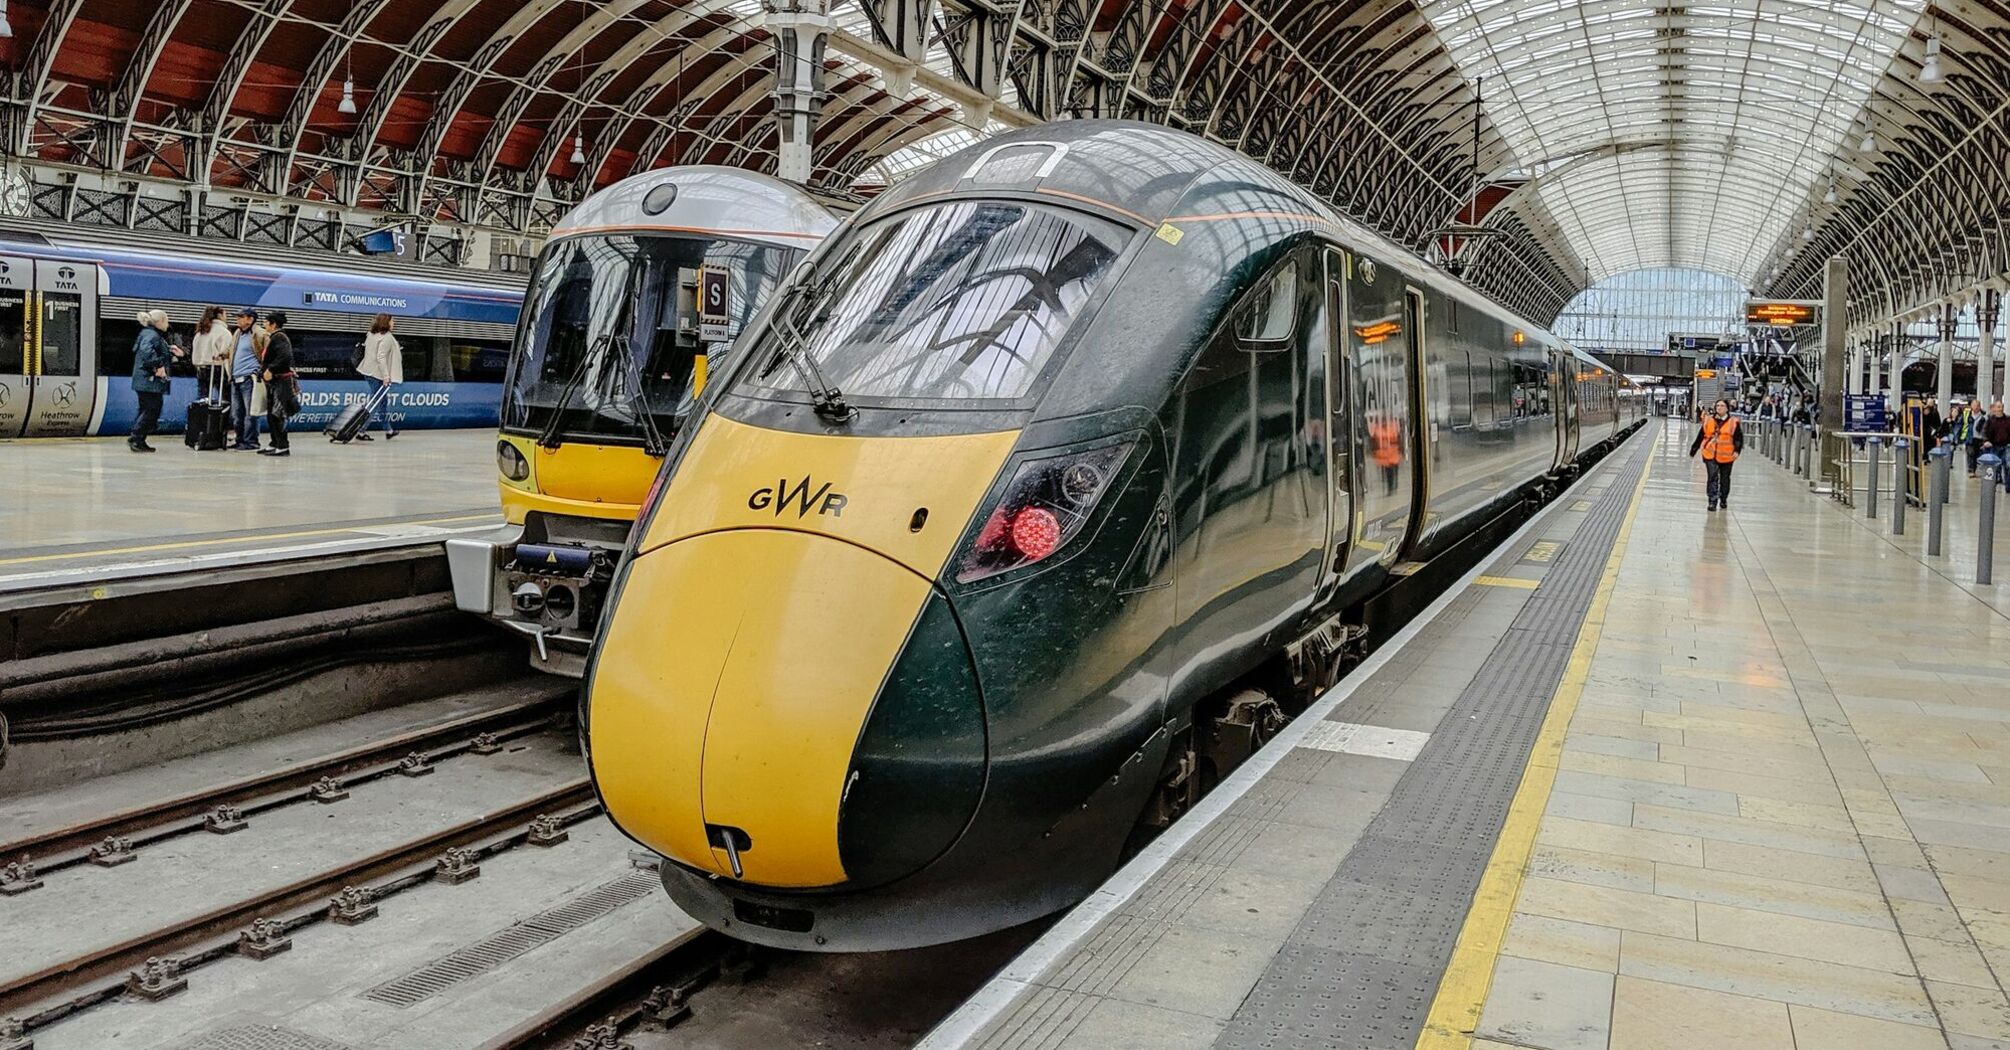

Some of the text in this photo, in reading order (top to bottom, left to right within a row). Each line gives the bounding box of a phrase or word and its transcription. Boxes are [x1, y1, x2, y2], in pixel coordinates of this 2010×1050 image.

[397, 235, 405, 256] 5
[55, 281, 78, 290] TATA
[710, 283, 721, 306] S
[314, 291, 407, 308] TATA COMMUNICATIONS
[45, 300, 54, 320] 1
[401, 393, 450, 406] CLOUDS
[40, 411, 80, 419] Heathrow
[748, 474, 848, 520] GWR
